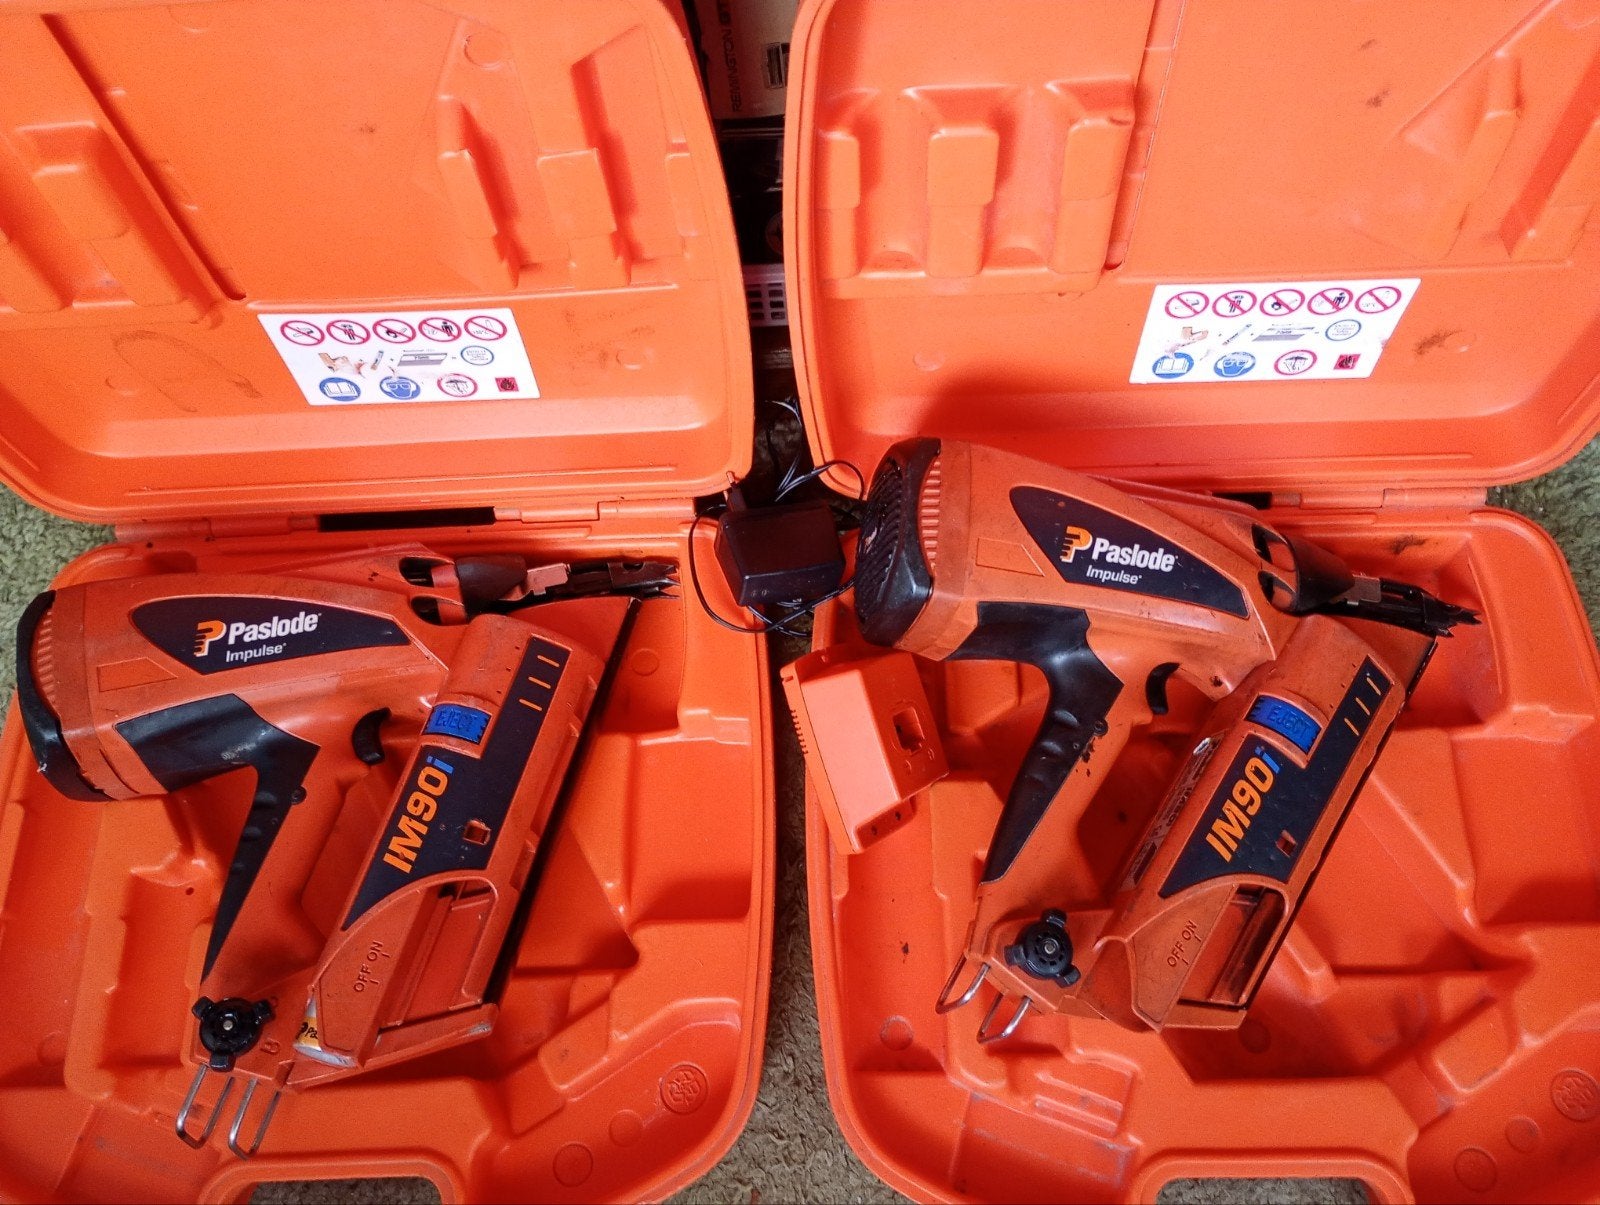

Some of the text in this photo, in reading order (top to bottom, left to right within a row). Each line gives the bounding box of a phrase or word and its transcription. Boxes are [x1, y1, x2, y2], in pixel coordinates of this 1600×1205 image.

[721, 28, 742, 112] REMINGTON
[1092, 537, 1175, 572] Paslode
[1086, 565, 1138, 584] Impulse
[228, 611, 319, 645] Paslode
[225, 643, 283, 663] Impulse
[434, 709, 478, 732] EJECT
[1266, 704, 1310, 739] EJECT
[383, 756, 455, 874] IM90i
[1205, 746, 1281, 863] IM90i
[1167, 920, 1198, 967] OFF ON
[353, 940, 384, 992] OFF ON
